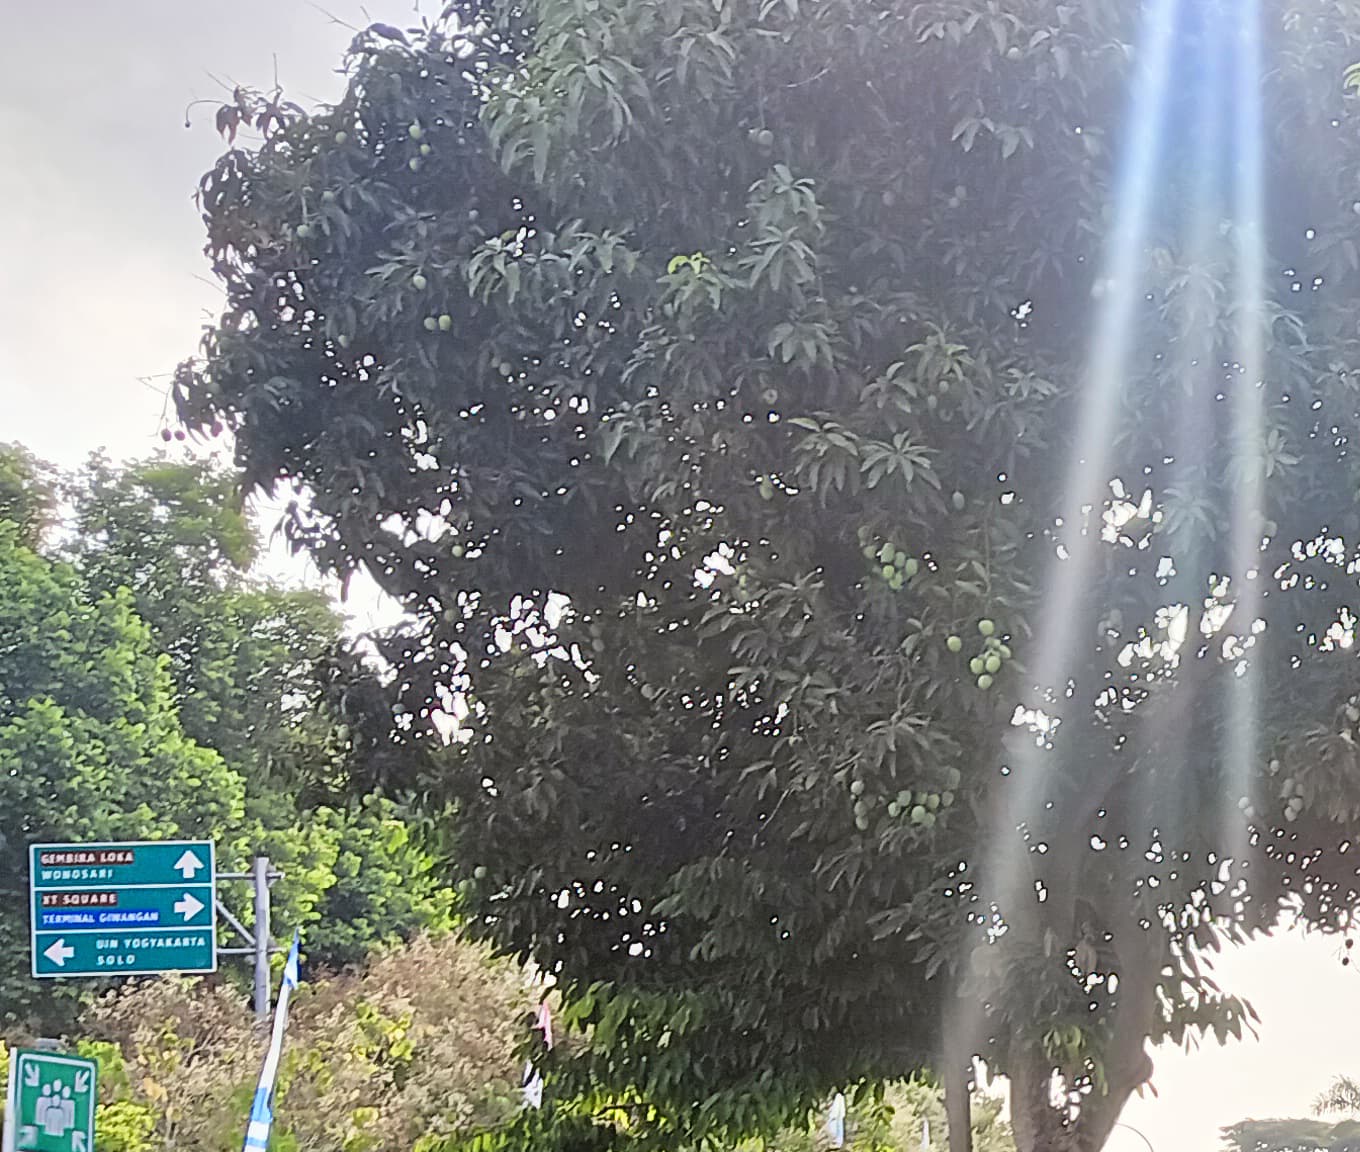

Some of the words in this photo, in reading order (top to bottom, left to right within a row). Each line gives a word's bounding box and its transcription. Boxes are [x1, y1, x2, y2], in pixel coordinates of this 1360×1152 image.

[41, 853, 95, 864] GEMBIRA
[100, 851, 134, 862] LOKA
[41, 869, 113, 880] WONOSARI
[62, 893, 117, 904] SQUARE
[42, 914, 95, 924] TERMINAL
[124, 937, 206, 948] YOGYAKARTA
[97, 954, 136, 965] SOLO
